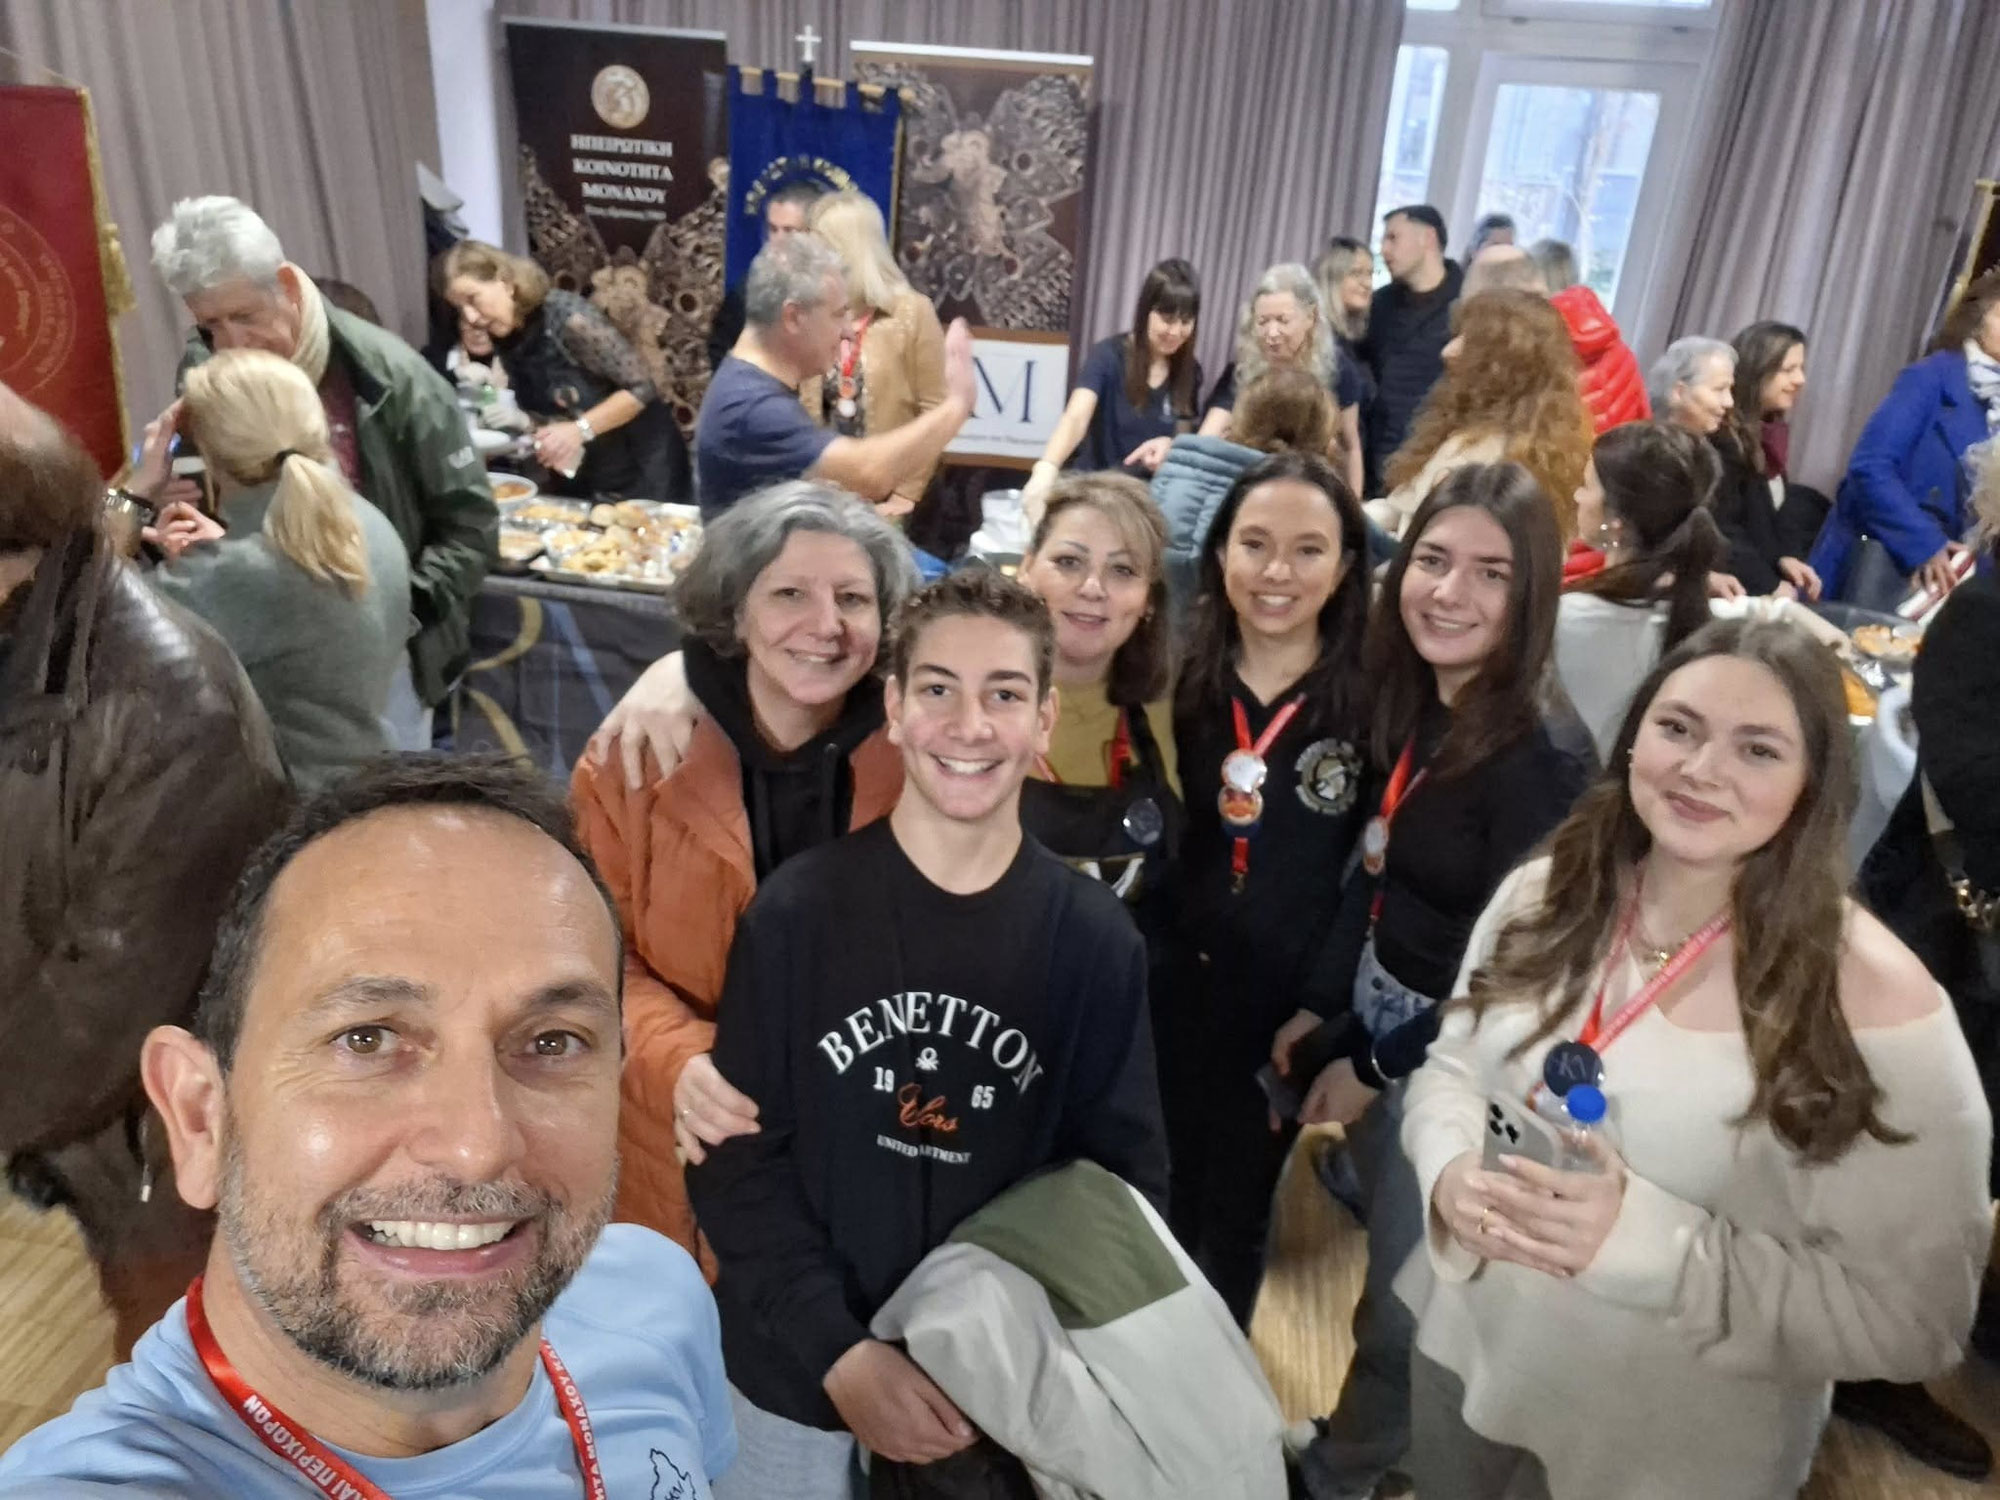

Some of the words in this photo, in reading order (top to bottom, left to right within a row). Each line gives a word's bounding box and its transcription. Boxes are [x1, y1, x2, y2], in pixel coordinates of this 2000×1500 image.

[582, 182, 666, 204] ΜΟΝΑΧΟΥ
[817, 991, 1043, 1094] BENETTON
[873, 1066, 895, 1093] 19
[971, 1085, 995, 1109] 65
[243, 1395, 338, 1487] ΠΕΡΙΧΩΡΩΝ
